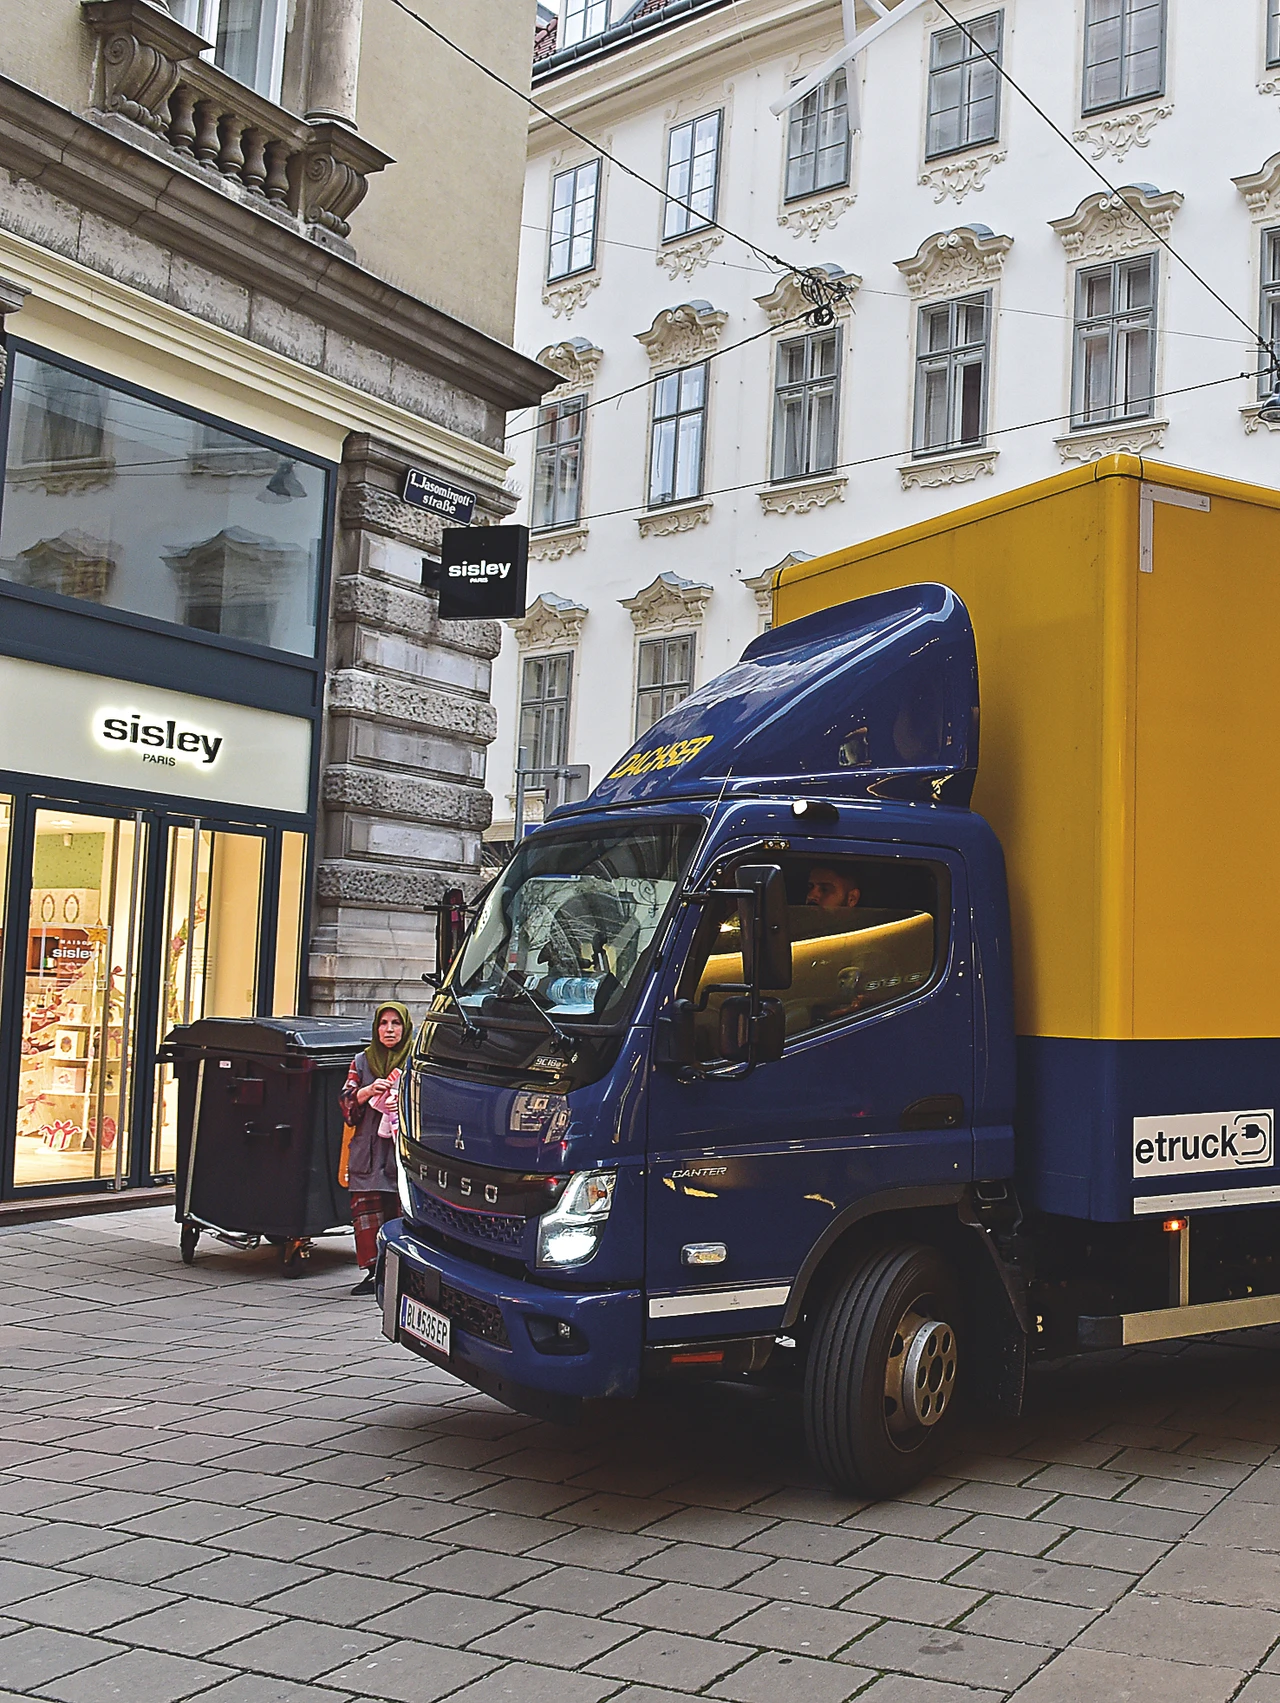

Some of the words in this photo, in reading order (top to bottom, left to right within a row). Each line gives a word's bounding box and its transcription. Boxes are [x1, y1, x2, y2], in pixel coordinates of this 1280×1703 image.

[422, 494, 456, 514] straße
[448, 559, 511, 578] sisley
[103, 714, 223, 763] sisley
[142, 753, 176, 767] PARIS
[607, 734, 715, 779] DACHSER
[1135, 1125, 1239, 1164] etruck
[419, 1164, 499, 1204] FUSO
[671, 1167, 727, 1179] CANTER
